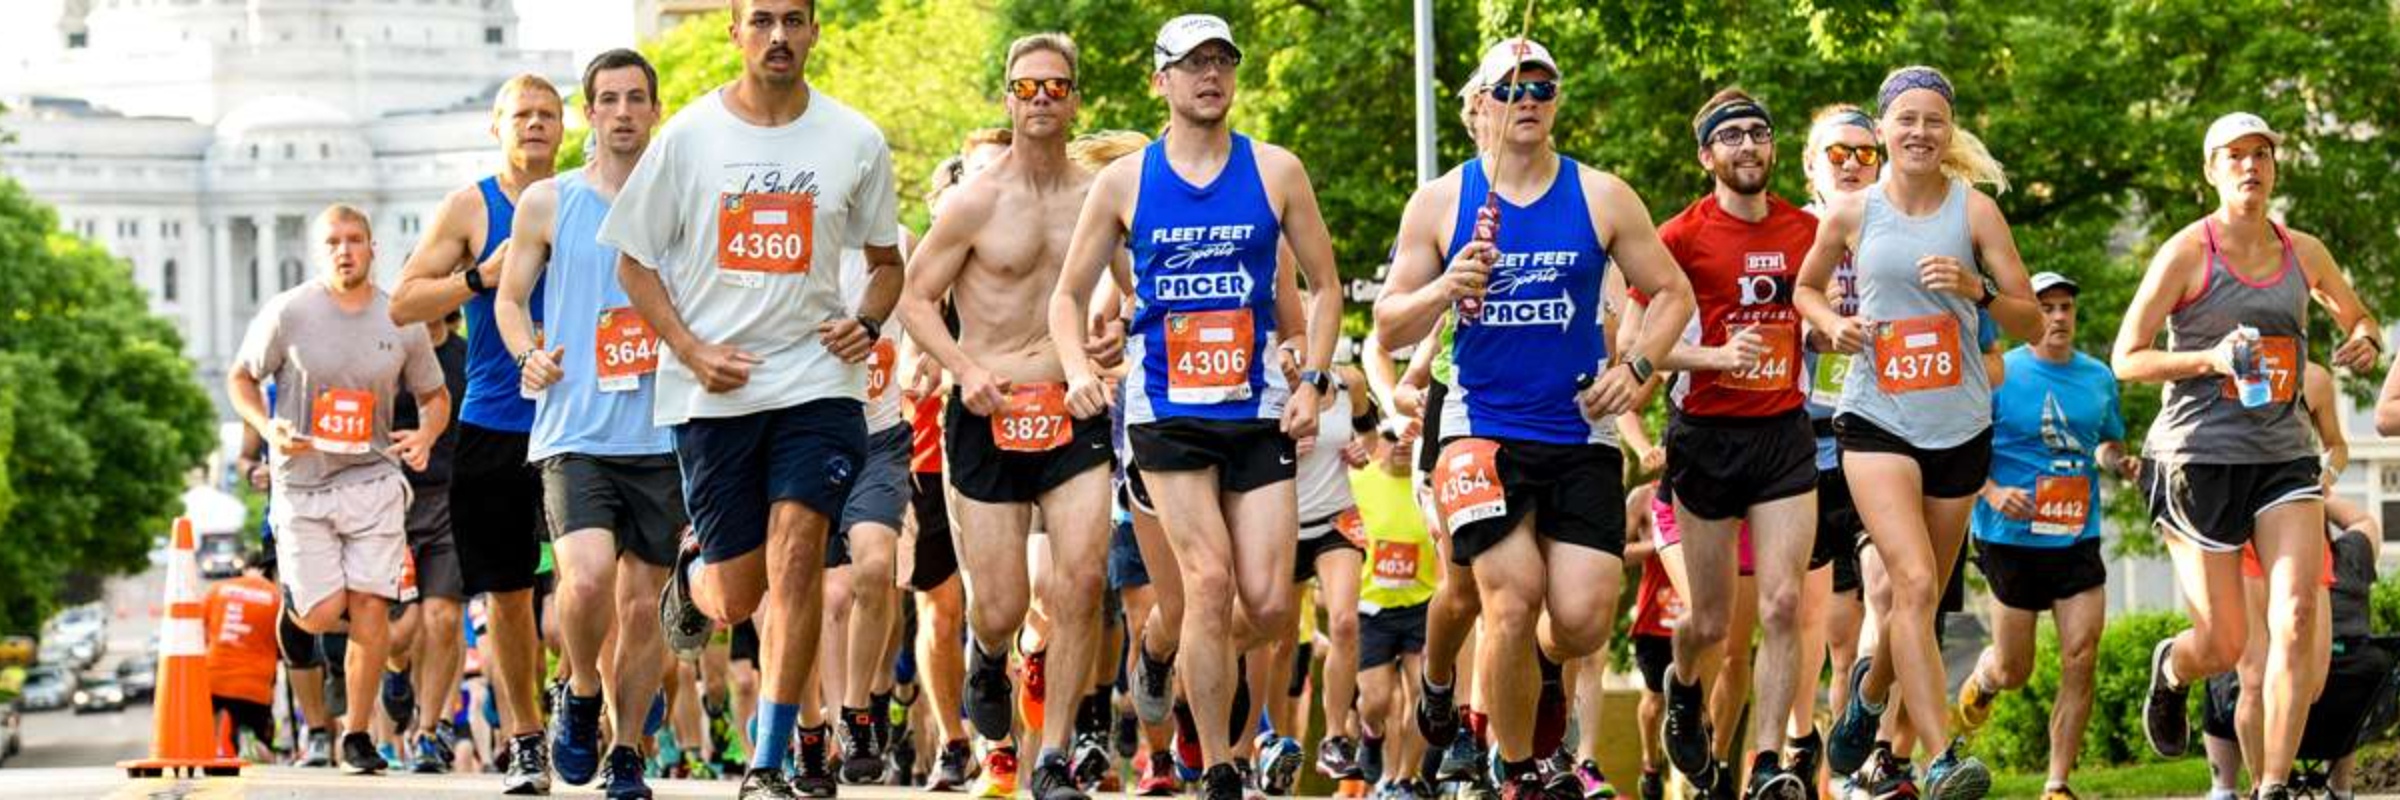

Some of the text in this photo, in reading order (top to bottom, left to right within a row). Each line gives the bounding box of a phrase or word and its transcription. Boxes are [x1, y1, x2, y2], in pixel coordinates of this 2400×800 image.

[727, 231, 802, 260] 4360
[1152, 224, 1255, 244] FLEET FEET
[1163, 241, 1246, 269] Sports
[1532, 251, 1579, 267] FEET
[1158, 275, 1246, 296] PACER
[1487, 267, 1567, 296] Sports
[1483, 301, 1568, 323] PACER
[1177, 348, 1247, 376] 4306
[1883, 351, 1953, 381] 4378
[317, 413, 365, 436] 4311
[1001, 415, 1064, 441] 3827
[1440, 466, 1492, 505] 4364
[2039, 499, 2083, 519] 4442
